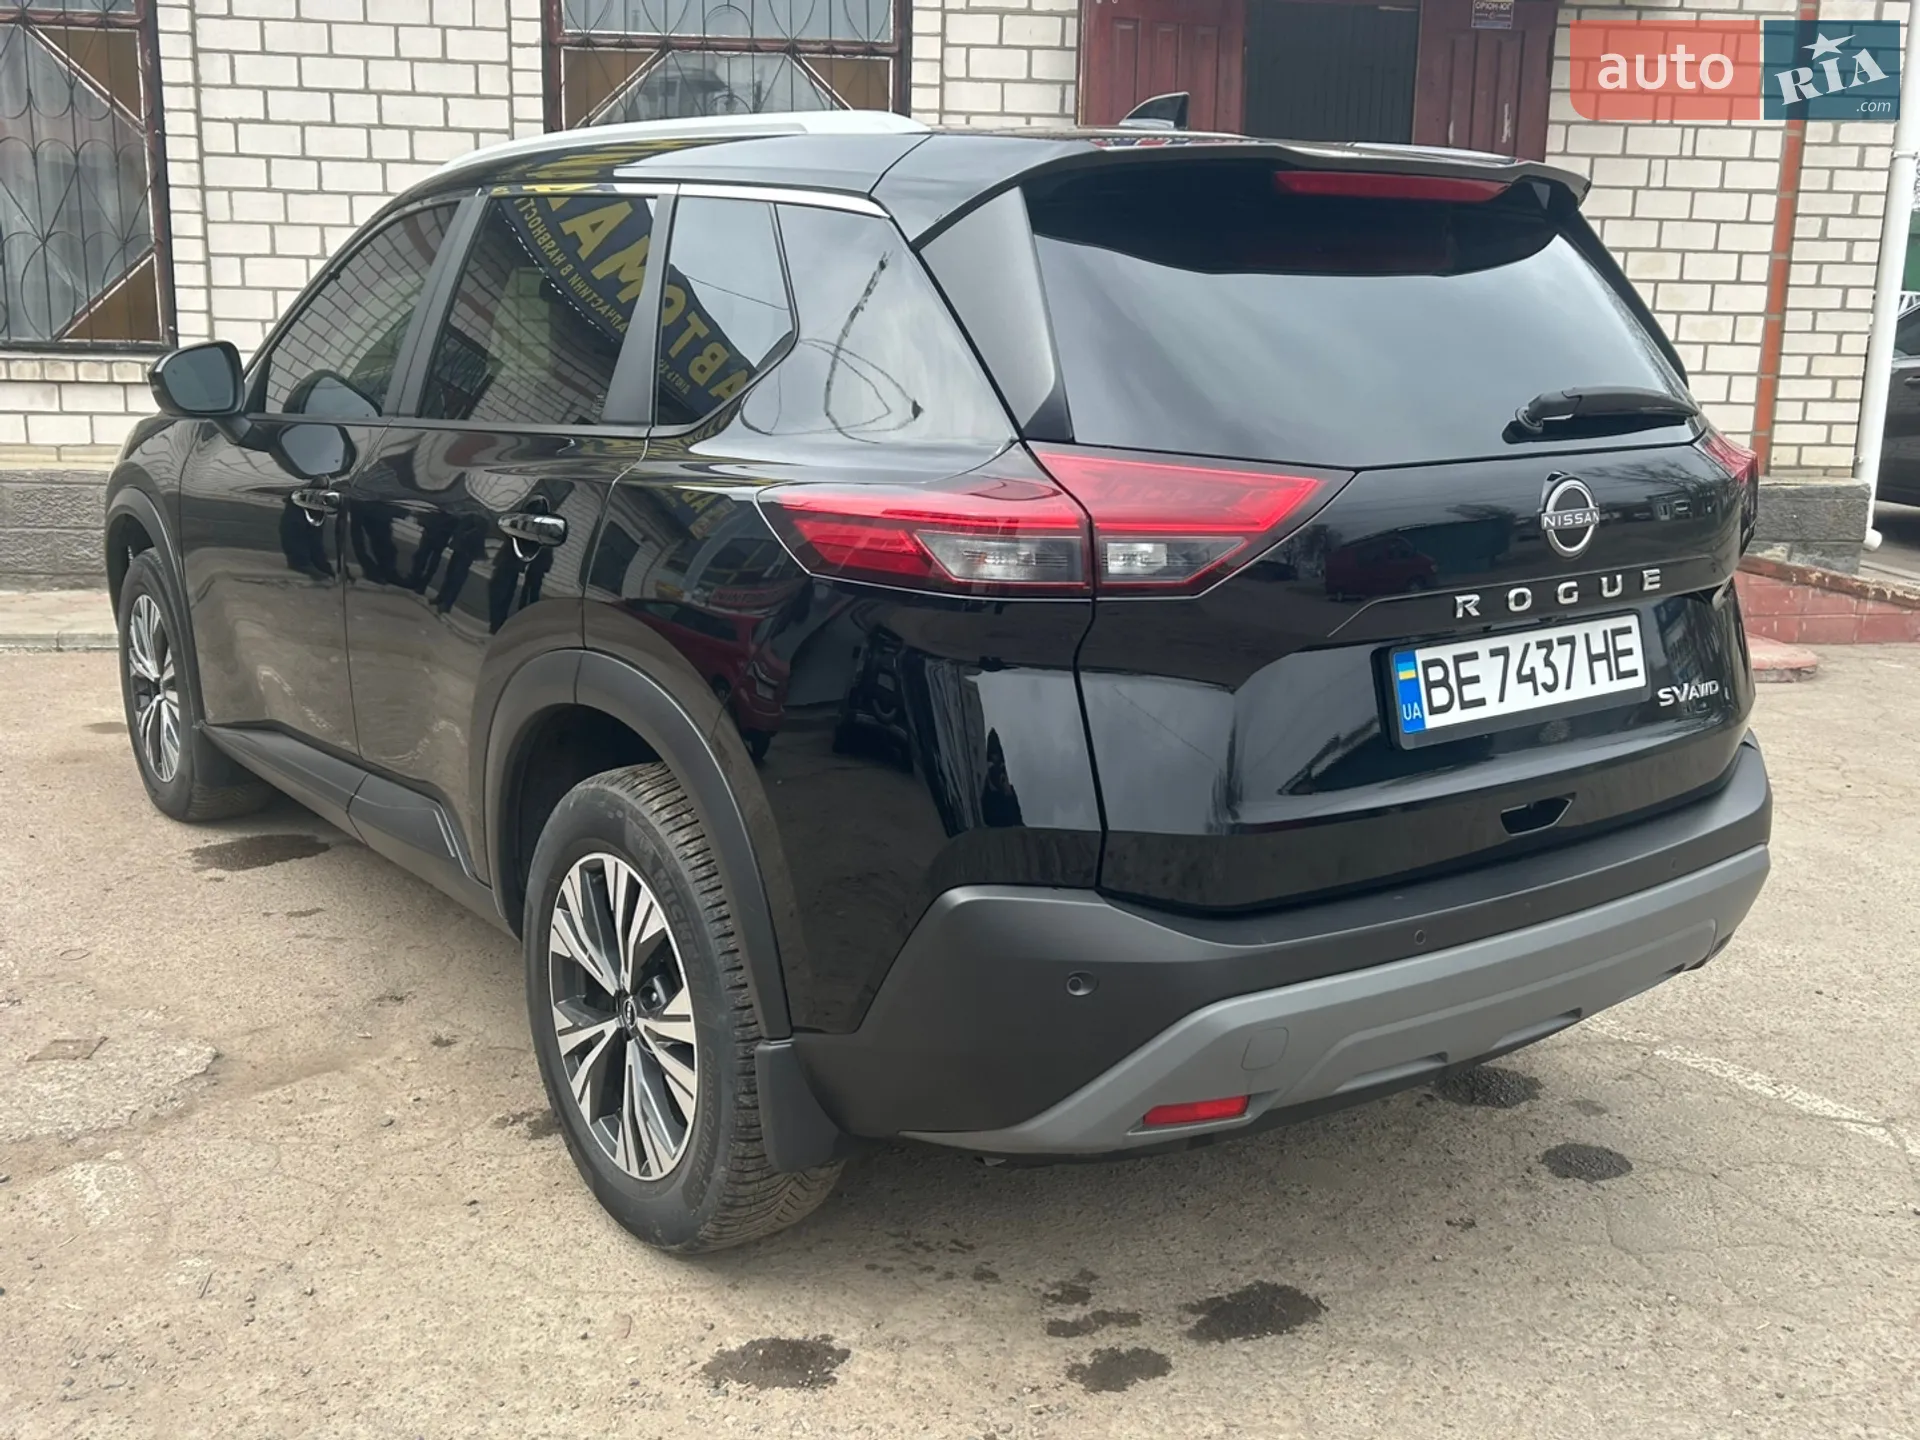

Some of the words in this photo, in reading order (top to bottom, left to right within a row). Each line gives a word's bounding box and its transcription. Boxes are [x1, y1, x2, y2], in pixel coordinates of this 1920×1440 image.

[1542, 506, 1600, 529] NISSAN
[1454, 568, 1662, 619] ROGUE
[1421, 651, 1487, 716] BE
[1488, 635, 1577, 704] 7437
[1584, 625, 1640, 686] HE
[1402, 703, 1423, 721] UA
